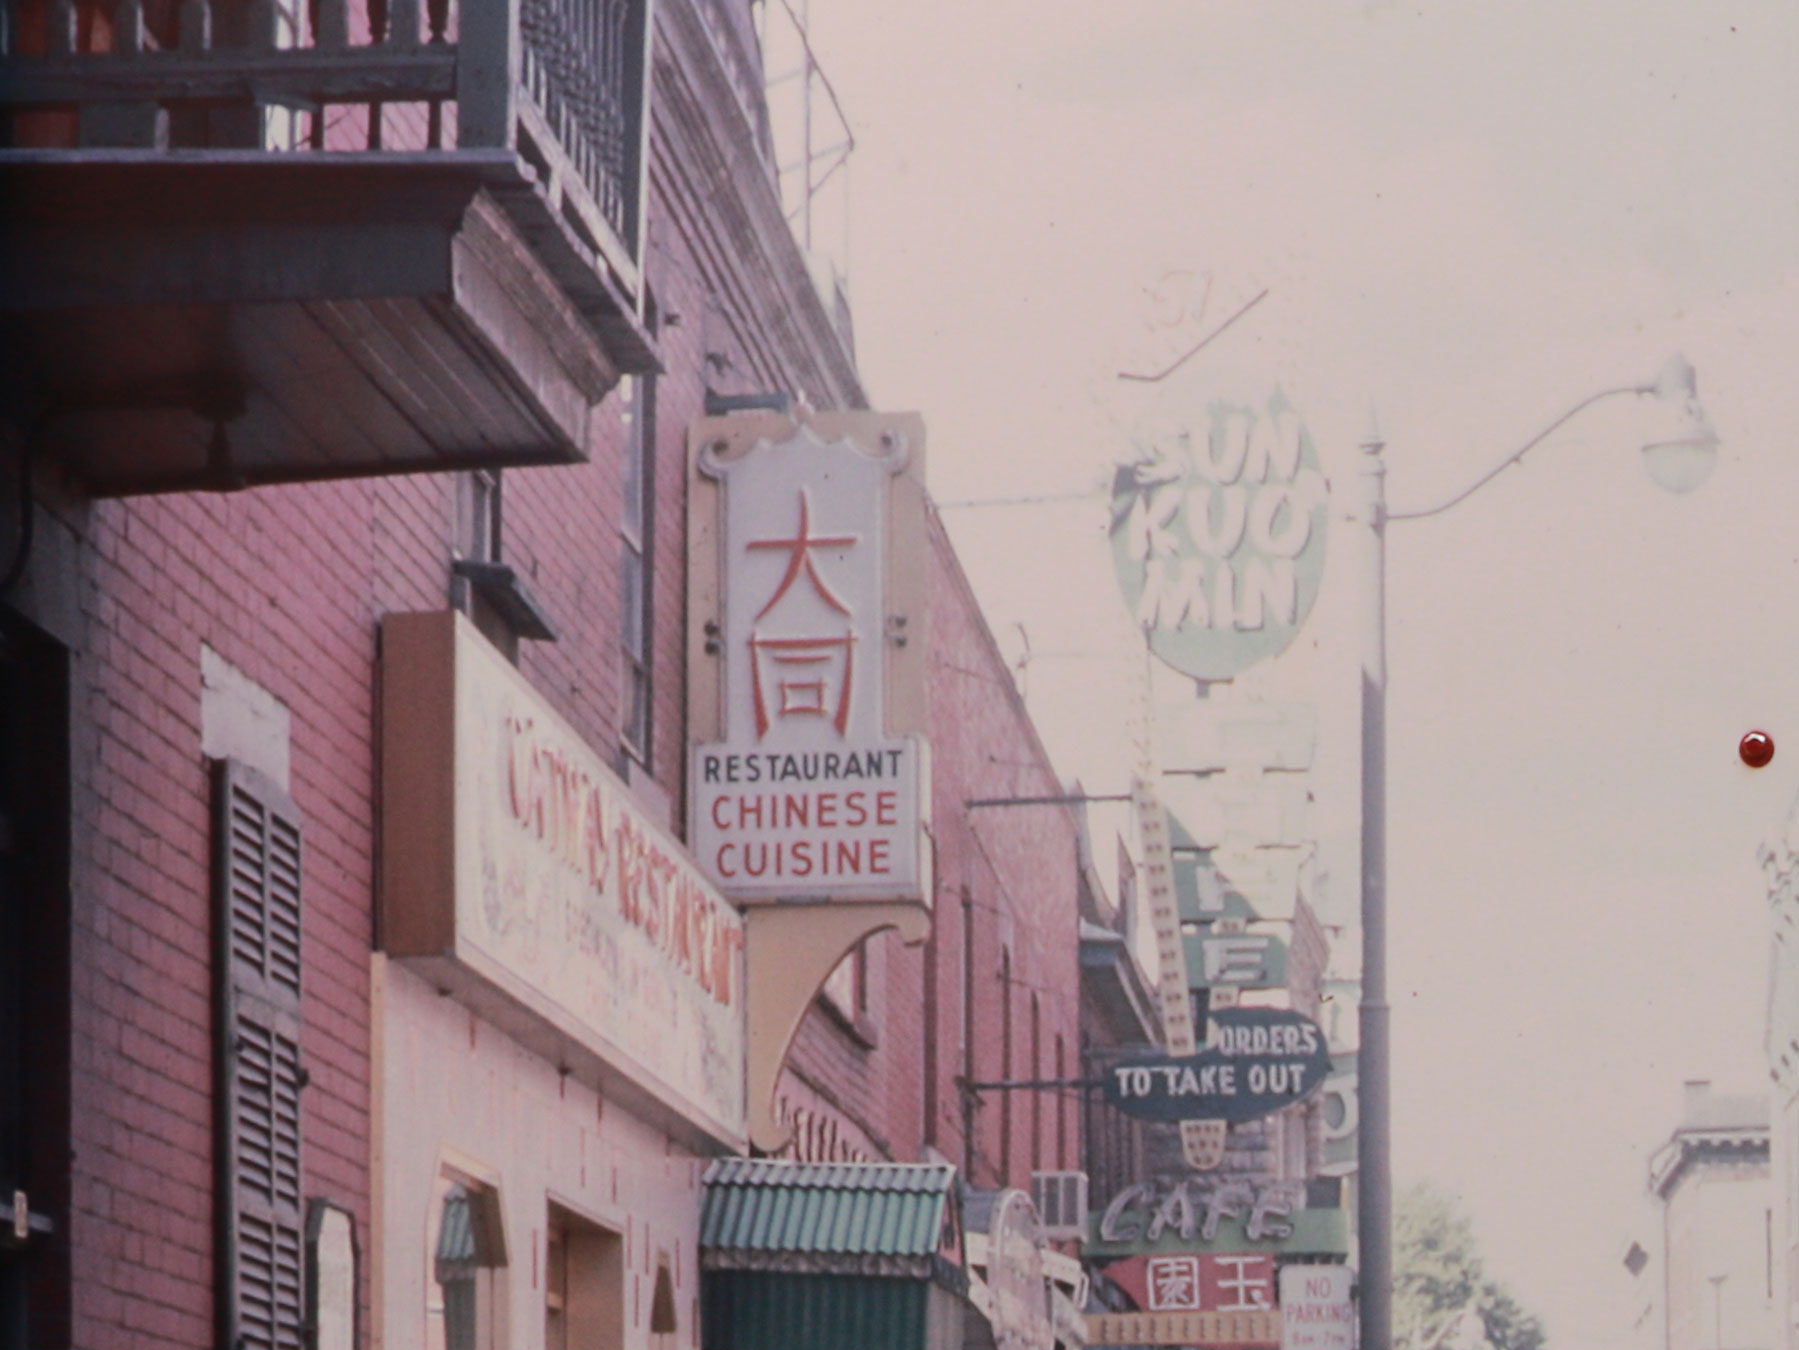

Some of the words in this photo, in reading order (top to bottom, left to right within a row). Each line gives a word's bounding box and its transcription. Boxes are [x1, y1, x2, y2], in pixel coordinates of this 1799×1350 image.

[1135, 412, 1303, 487] SUN
[1128, 482, 1313, 561] KUO
[1138, 557, 1299, 632] MIN
[704, 750, 903, 783] RESTAURANT
[711, 791, 898, 831] CHINESE
[716, 839, 891, 878] CUISINE
[1219, 1023, 1318, 1056] ORDERS
[1114, 1066, 1151, 1097] TO
[1162, 1065, 1237, 1096] TAKE
[1249, 1063, 1306, 1095] OUT
[1305, 1277, 1332, 1299] NO
[1286, 1302, 1351, 1323] PARKING
